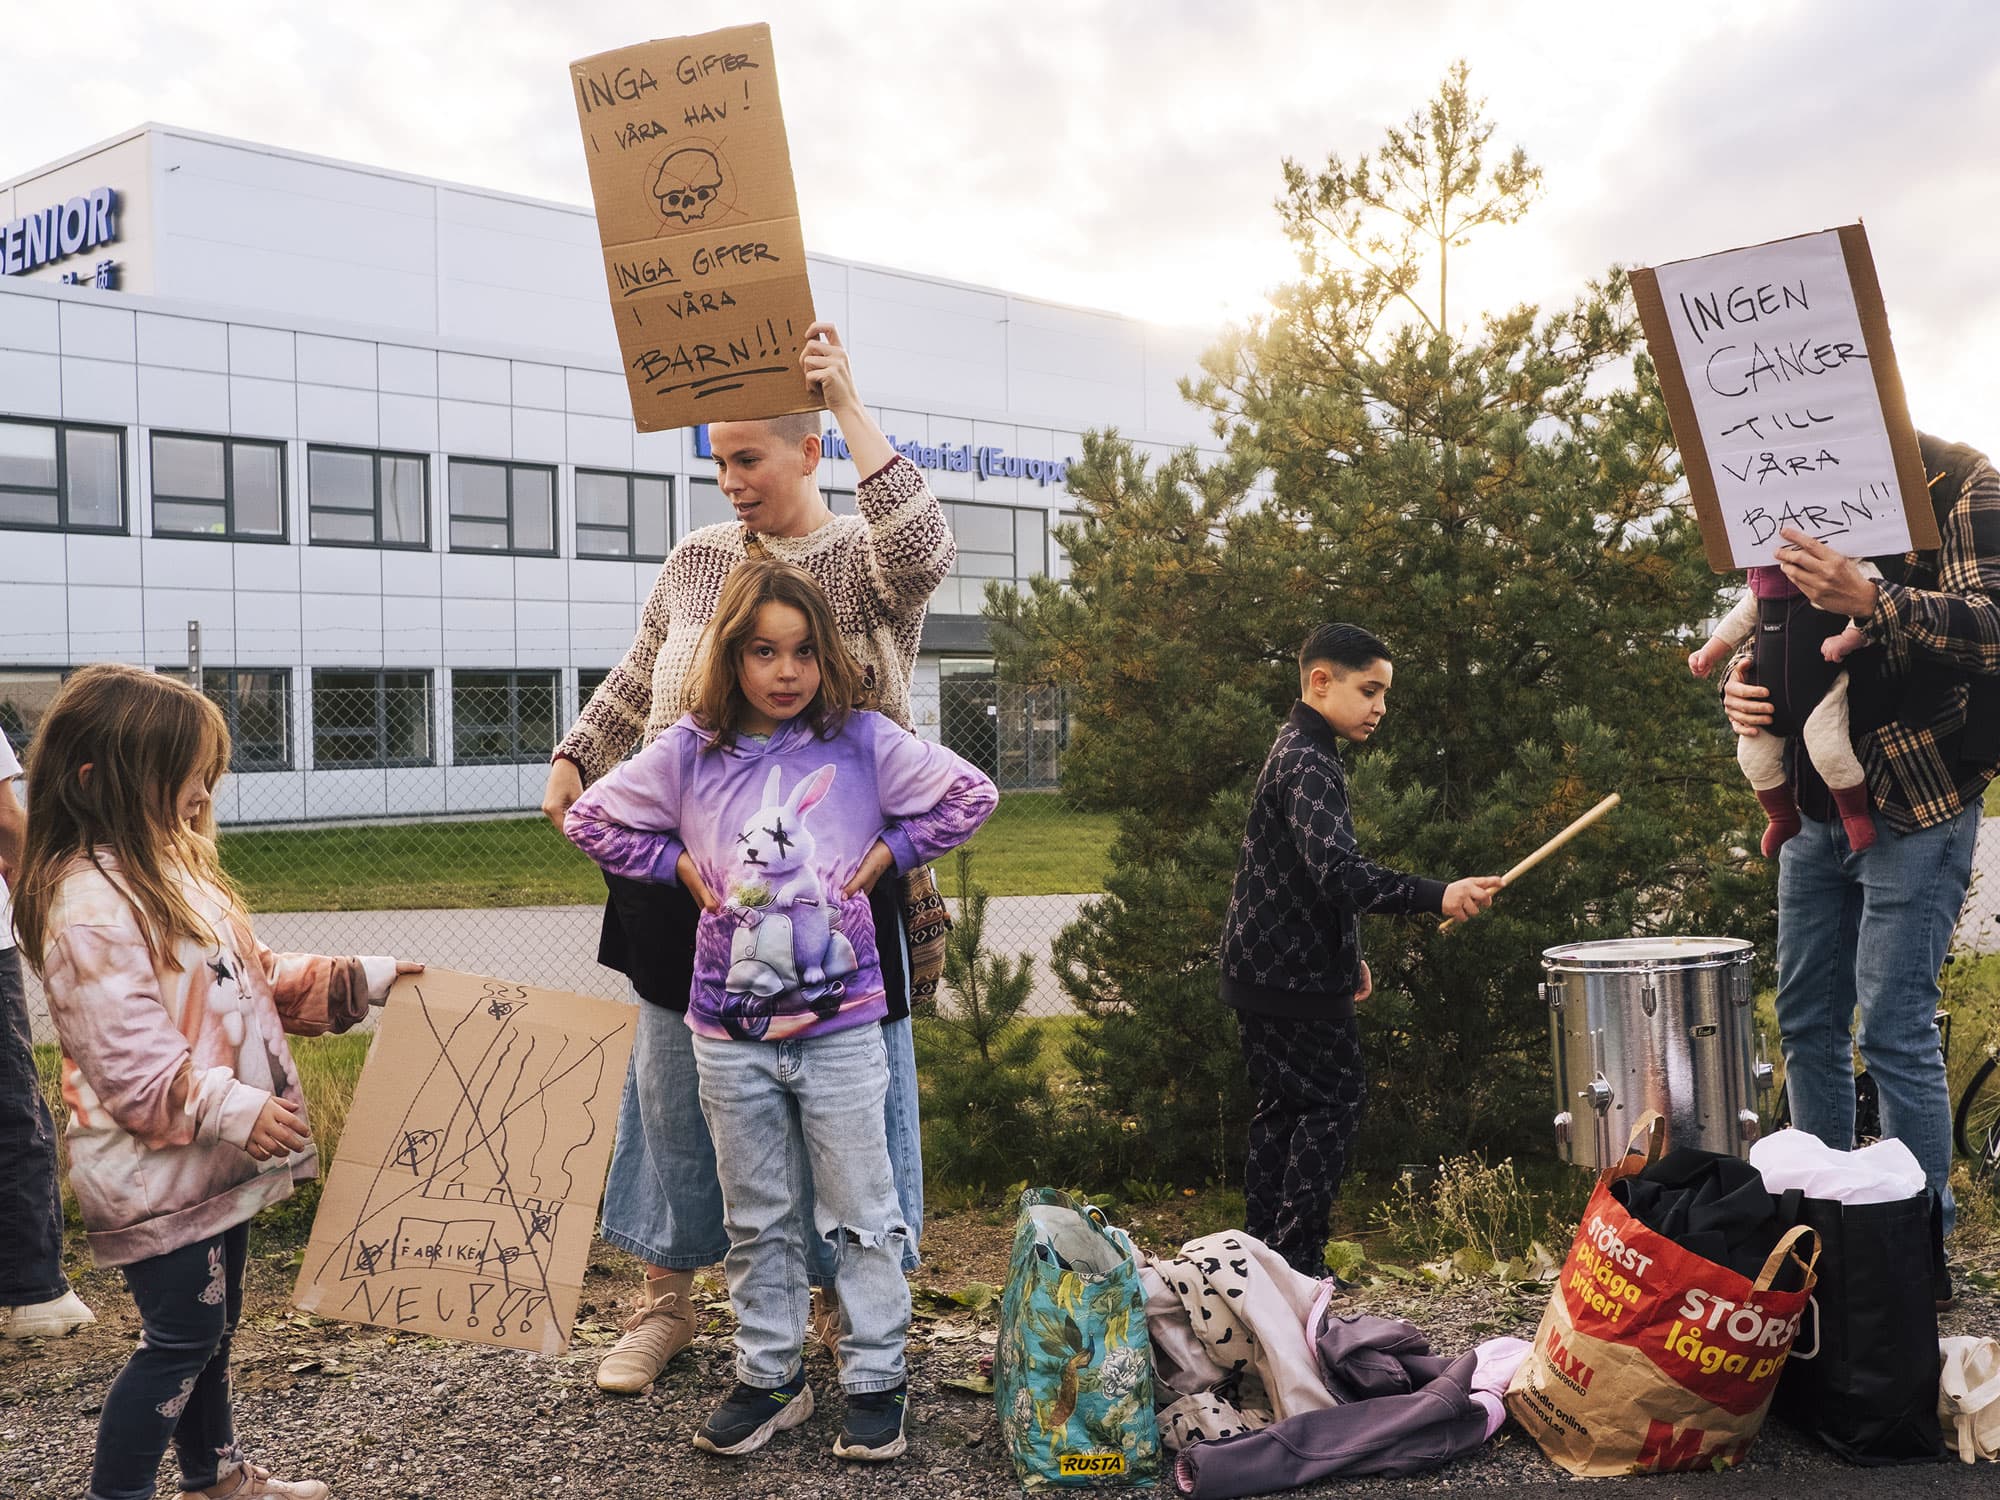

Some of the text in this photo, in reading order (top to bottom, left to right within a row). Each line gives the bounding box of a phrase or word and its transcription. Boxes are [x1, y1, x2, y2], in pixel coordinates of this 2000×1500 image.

[579, 53, 759, 113] INGA GIFTER
[590, 134, 600, 153] I
[614, 120, 668, 150] VÅRA
[683, 101, 728, 128] HAV
[613, 243, 780, 289] INGA GIFTER
[632, 290, 737, 327] I VÅRA
[1679, 279, 1809, 344] INGEN
[632, 318, 798, 384] BARN!!!
[1705, 338, 1868, 397] CANCER
[1721, 410, 1834, 440] TILL
[1721, 449, 1840, 485] VÅRA
[1588, 1216, 1653, 1278] STÖRST
[1569, 1269, 1623, 1323] priser!
[1593, 1255, 1642, 1304] låga
[1545, 1325, 1595, 1390] MAXI
[1664, 1320, 1749, 1375] låga
[1555, 1408, 1588, 1436] online
[1064, 1456, 1121, 1472] RUSTA
